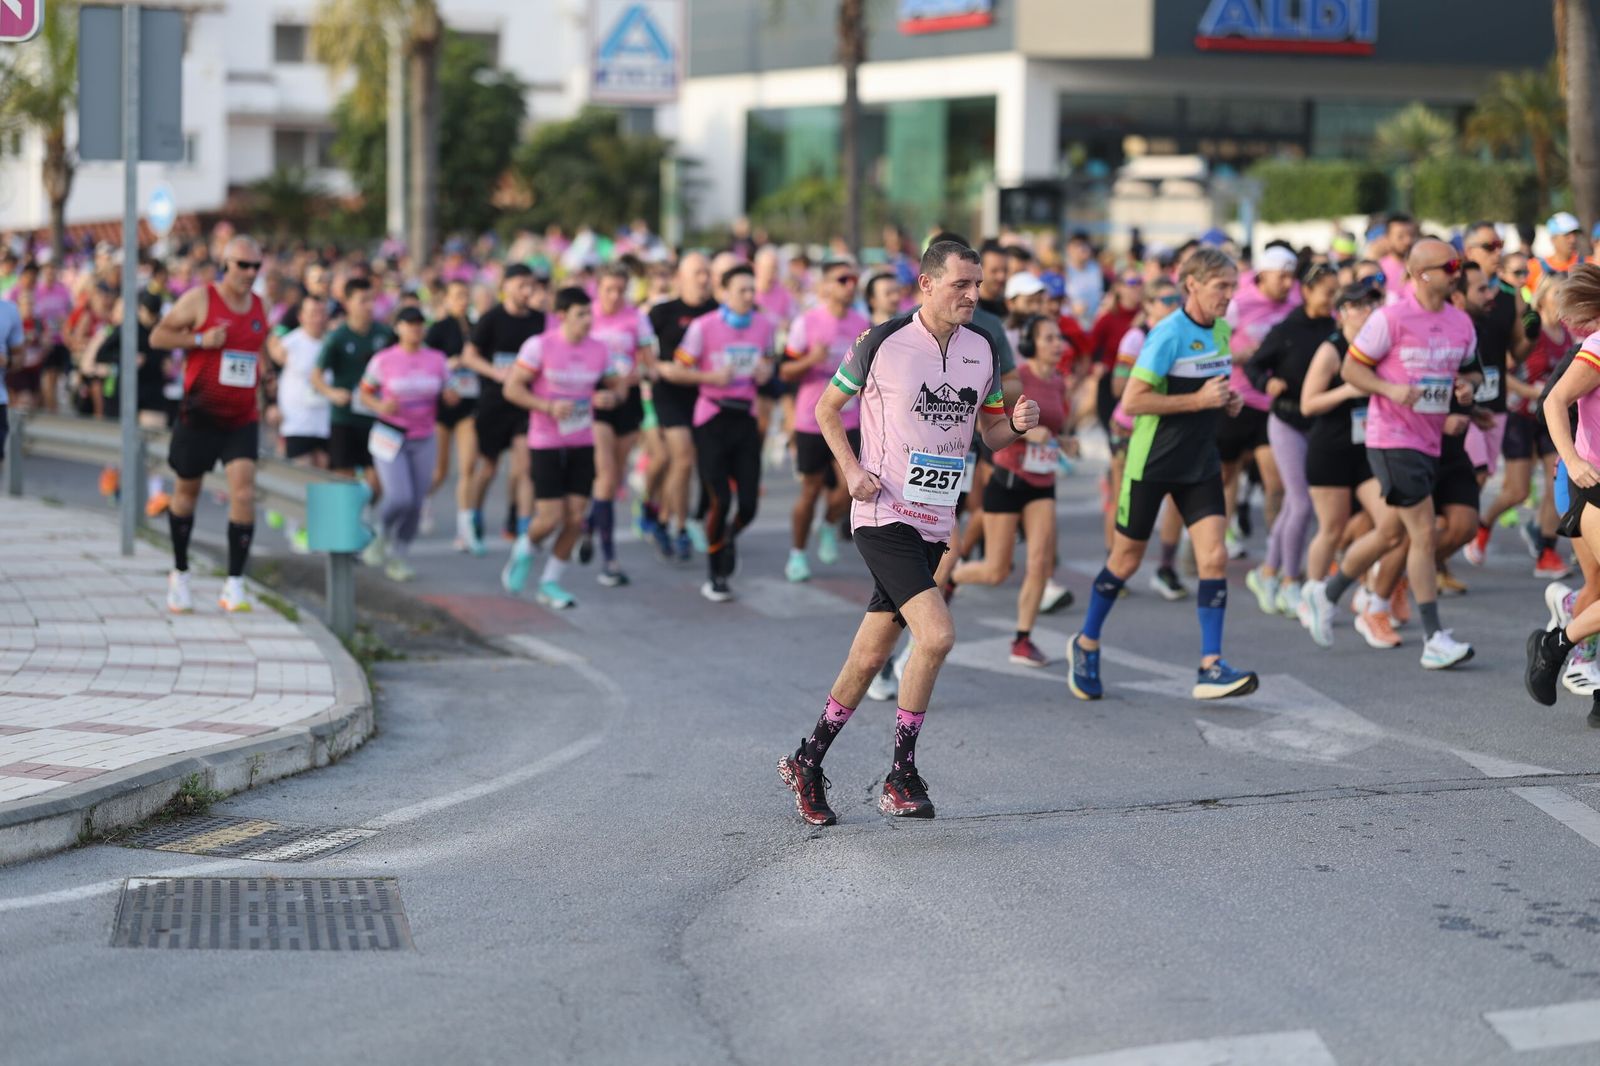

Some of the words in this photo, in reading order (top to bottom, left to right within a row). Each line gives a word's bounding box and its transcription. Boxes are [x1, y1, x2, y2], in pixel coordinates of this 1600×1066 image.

[1198, 0, 1377, 42] ALDI
[920, 413, 968, 424] TRAIL
[908, 467, 962, 490] 2257
[903, 509, 939, 522] RECAMBIO
